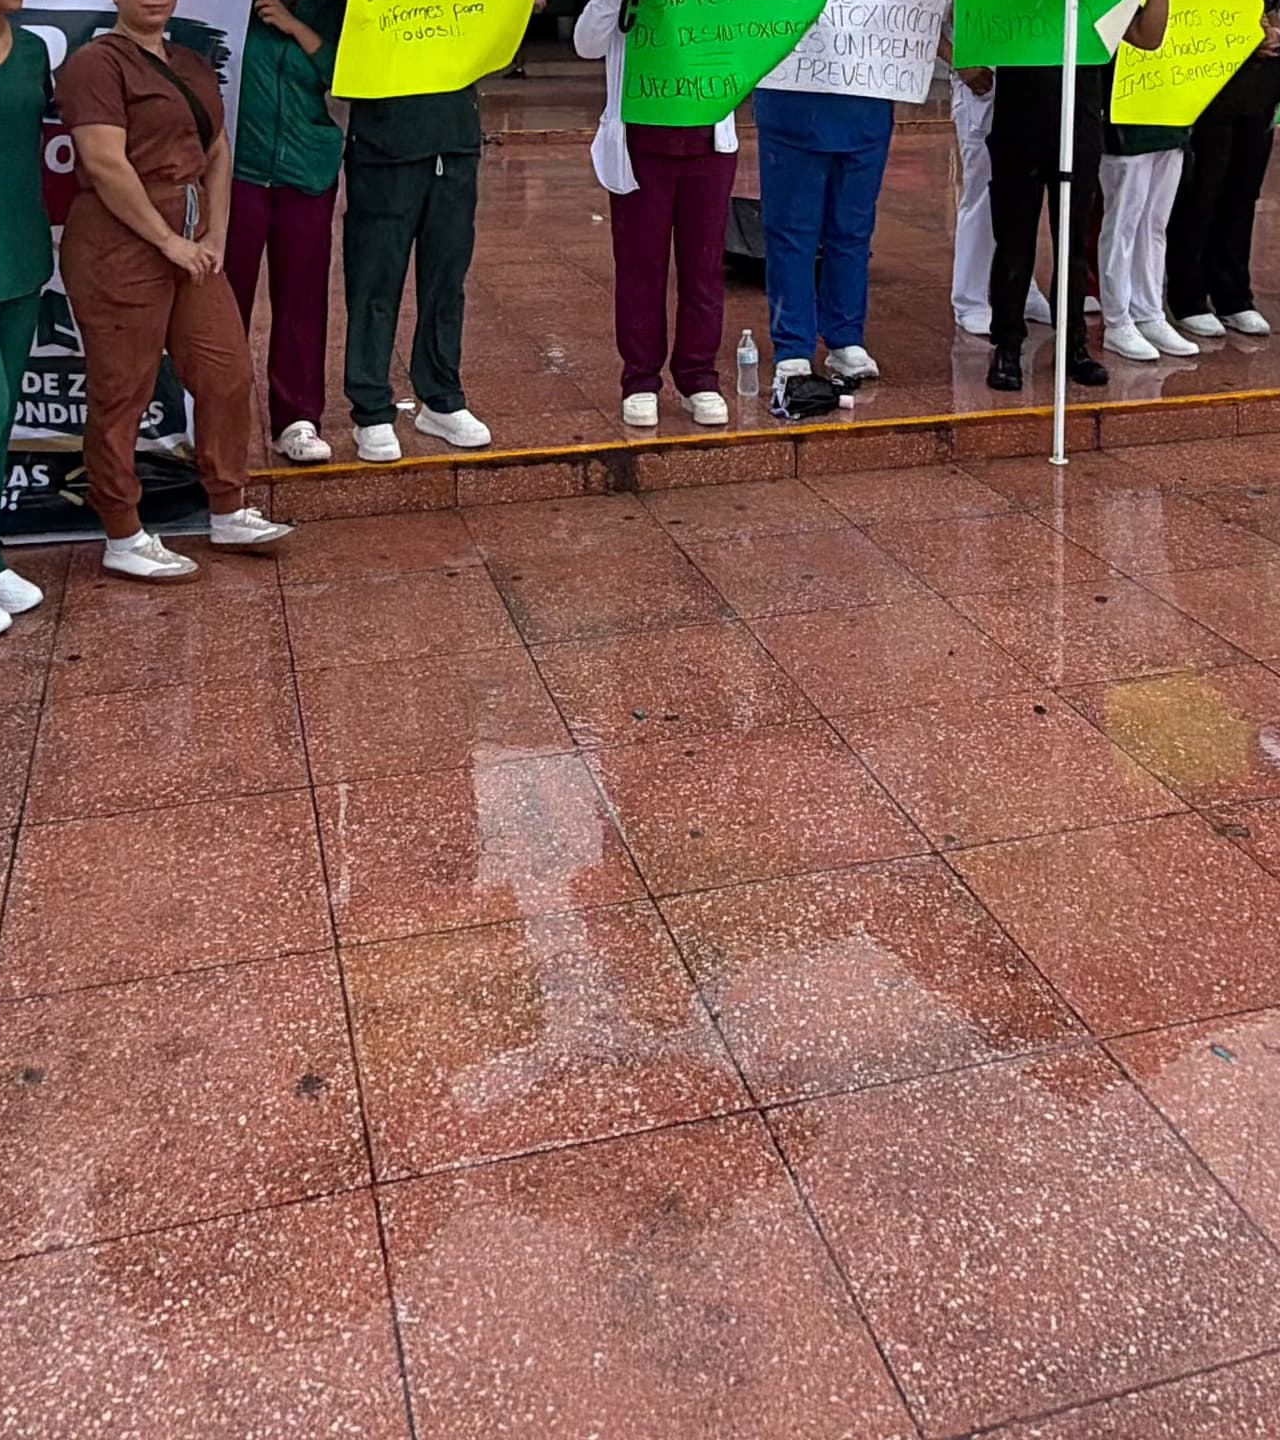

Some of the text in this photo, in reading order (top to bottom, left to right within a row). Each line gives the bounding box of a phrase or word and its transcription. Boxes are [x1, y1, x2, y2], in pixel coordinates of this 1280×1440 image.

[633, 19, 817, 50] DE DESINTOXICAC
[21, 371, 63, 397] DE
